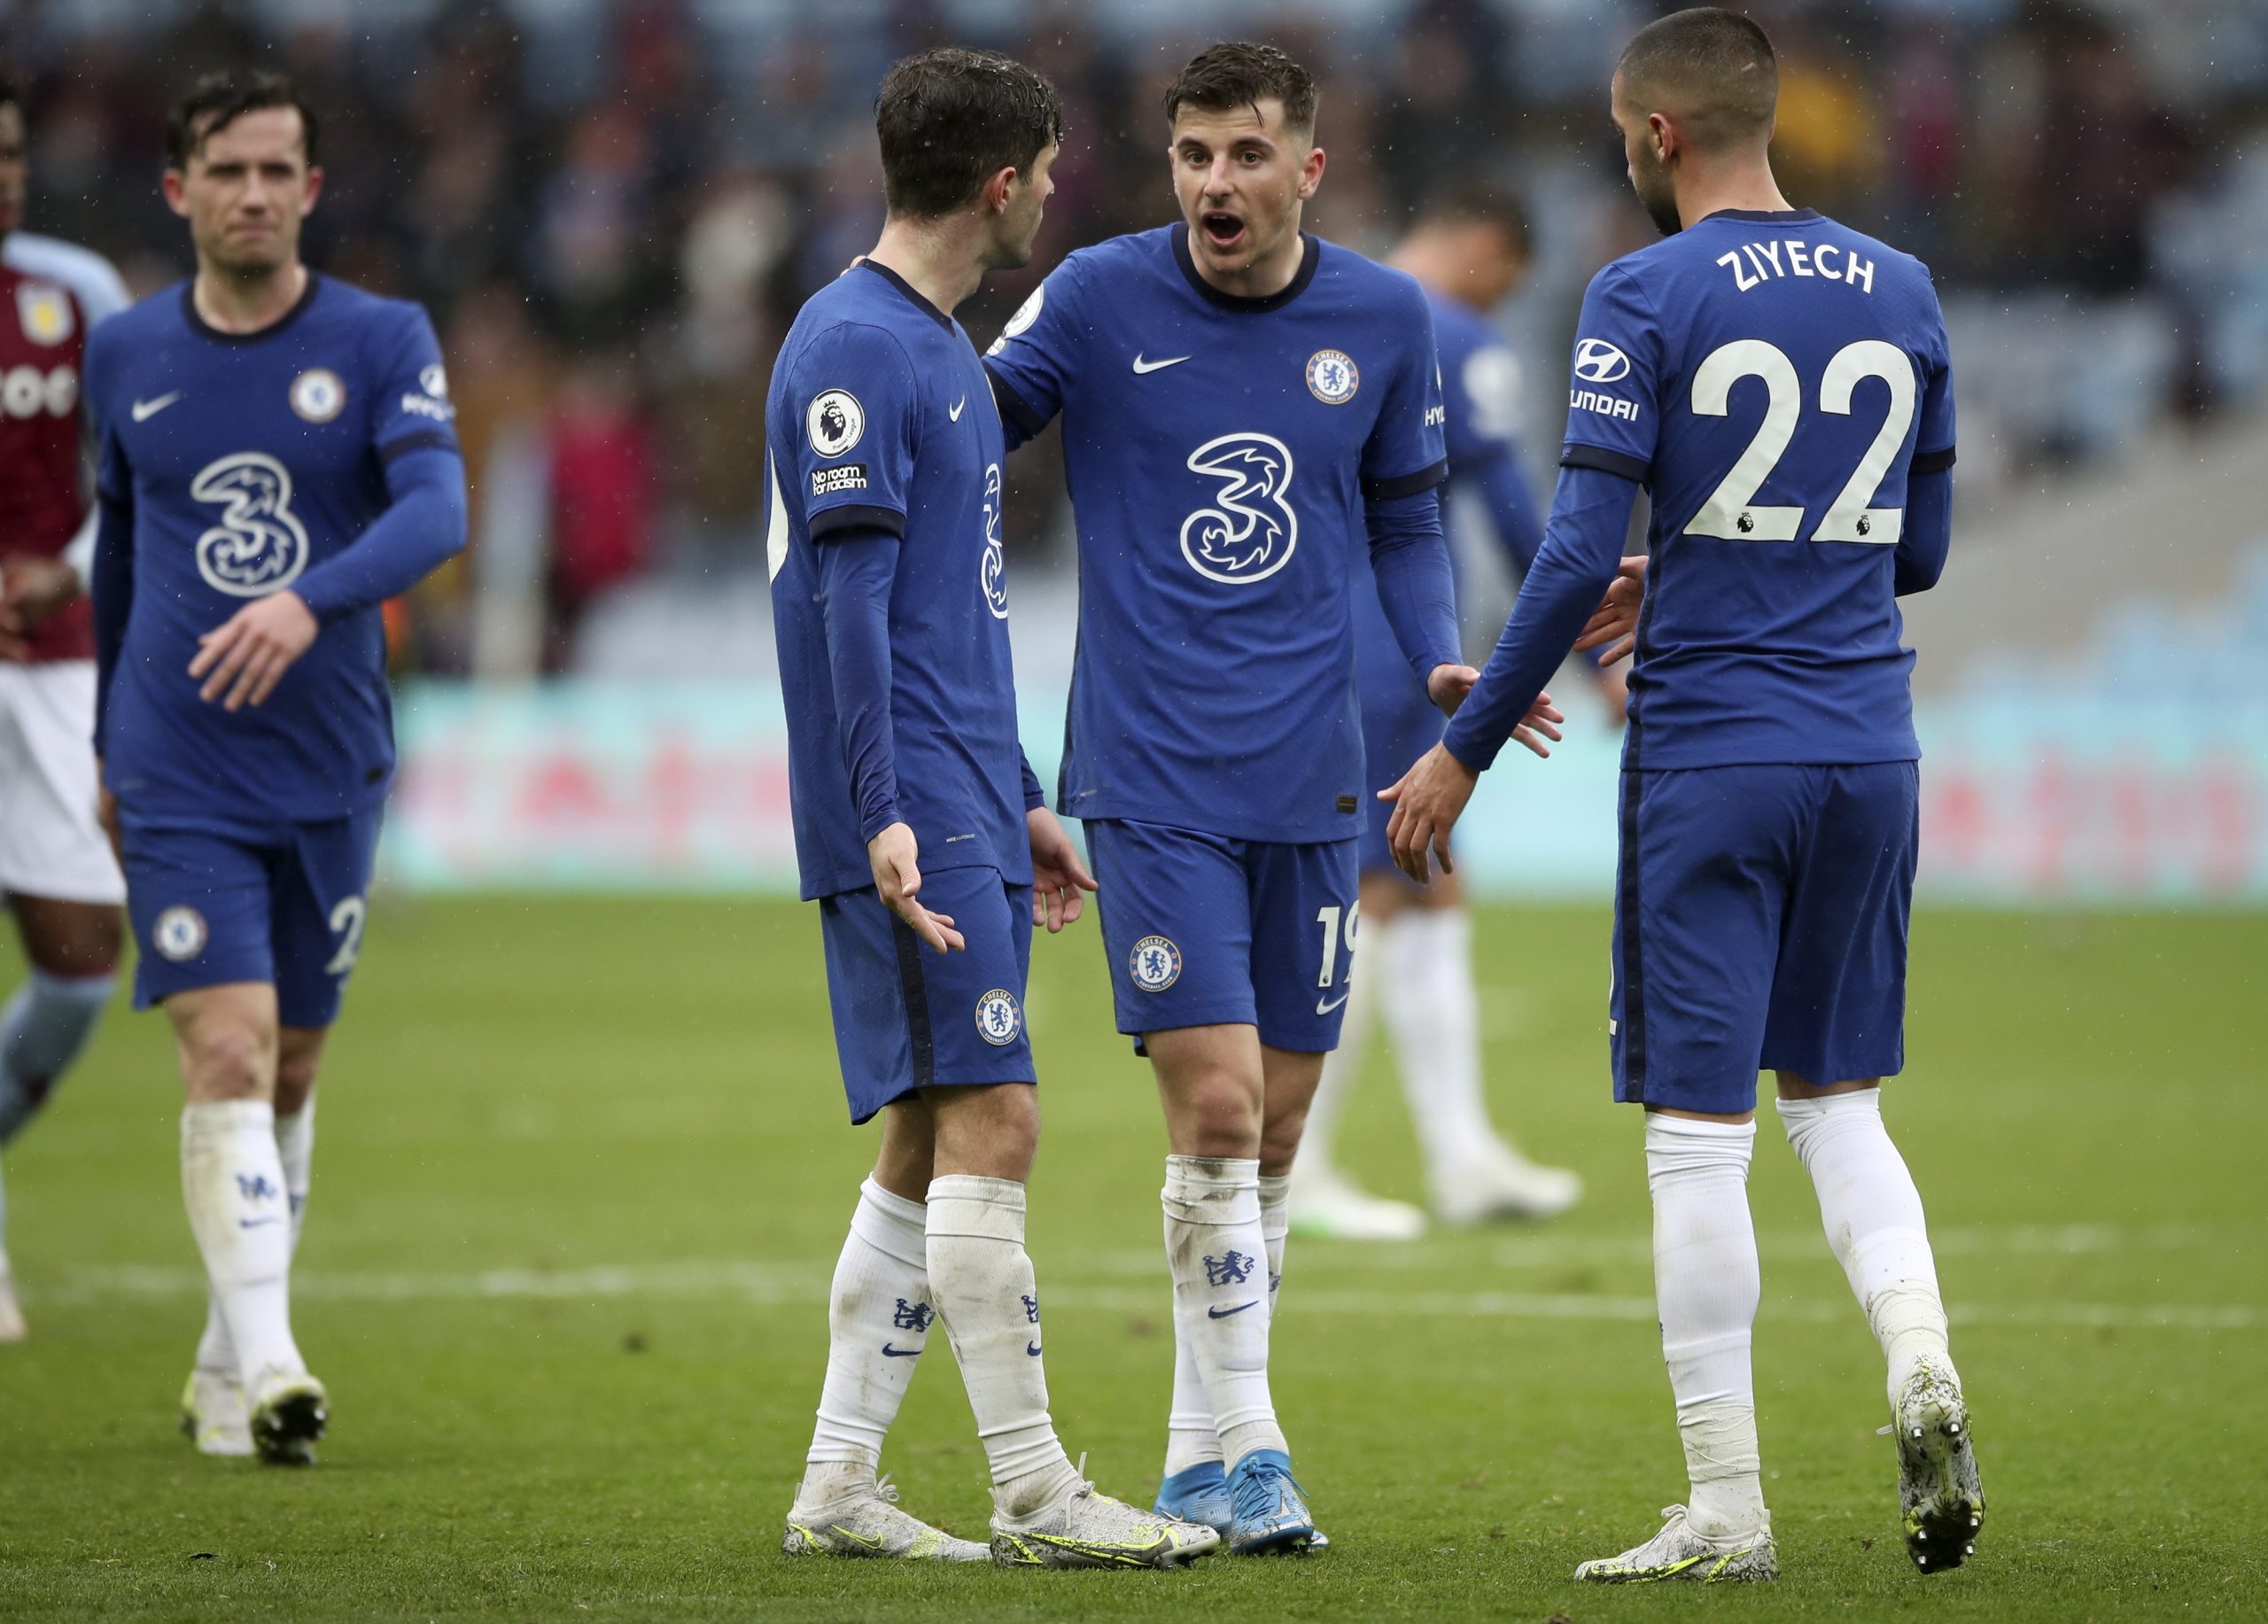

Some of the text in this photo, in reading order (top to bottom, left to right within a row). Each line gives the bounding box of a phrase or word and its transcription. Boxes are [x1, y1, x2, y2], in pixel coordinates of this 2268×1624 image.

[1716, 240, 1875, 294] ZIYECH
[1316, 352, 1349, 366] CHELSEA
[1682, 338, 1916, 544] 22
[812, 466, 860, 485] No room
[812, 478, 867, 497] for racism
[1136, 938, 1169, 952] CHELSEA
[983, 991, 1012, 1004] CHELSEA
